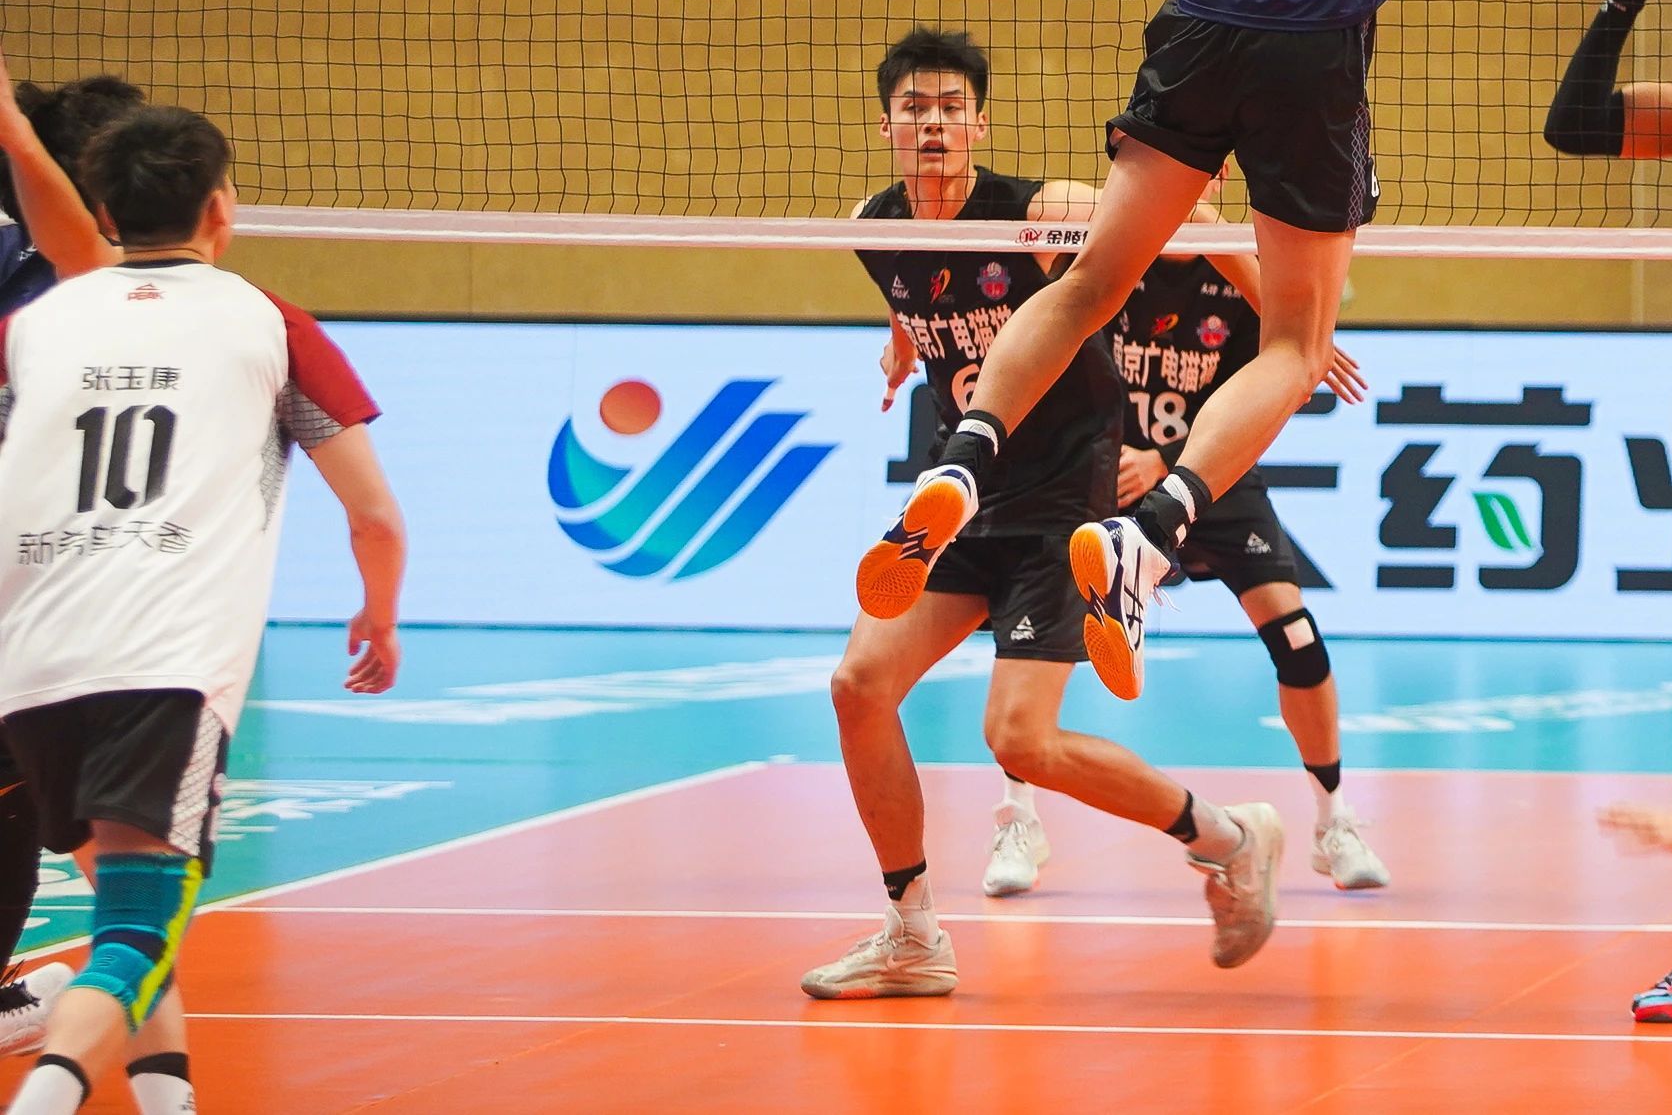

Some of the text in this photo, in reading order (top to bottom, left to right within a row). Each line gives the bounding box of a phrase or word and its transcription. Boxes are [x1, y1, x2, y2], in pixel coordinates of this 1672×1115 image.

[1047, 230, 1088, 245] 金陵
[82, 366, 182, 391] 张玉康
[1128, 392, 1190, 446] 18
[75, 404, 178, 513] 10
